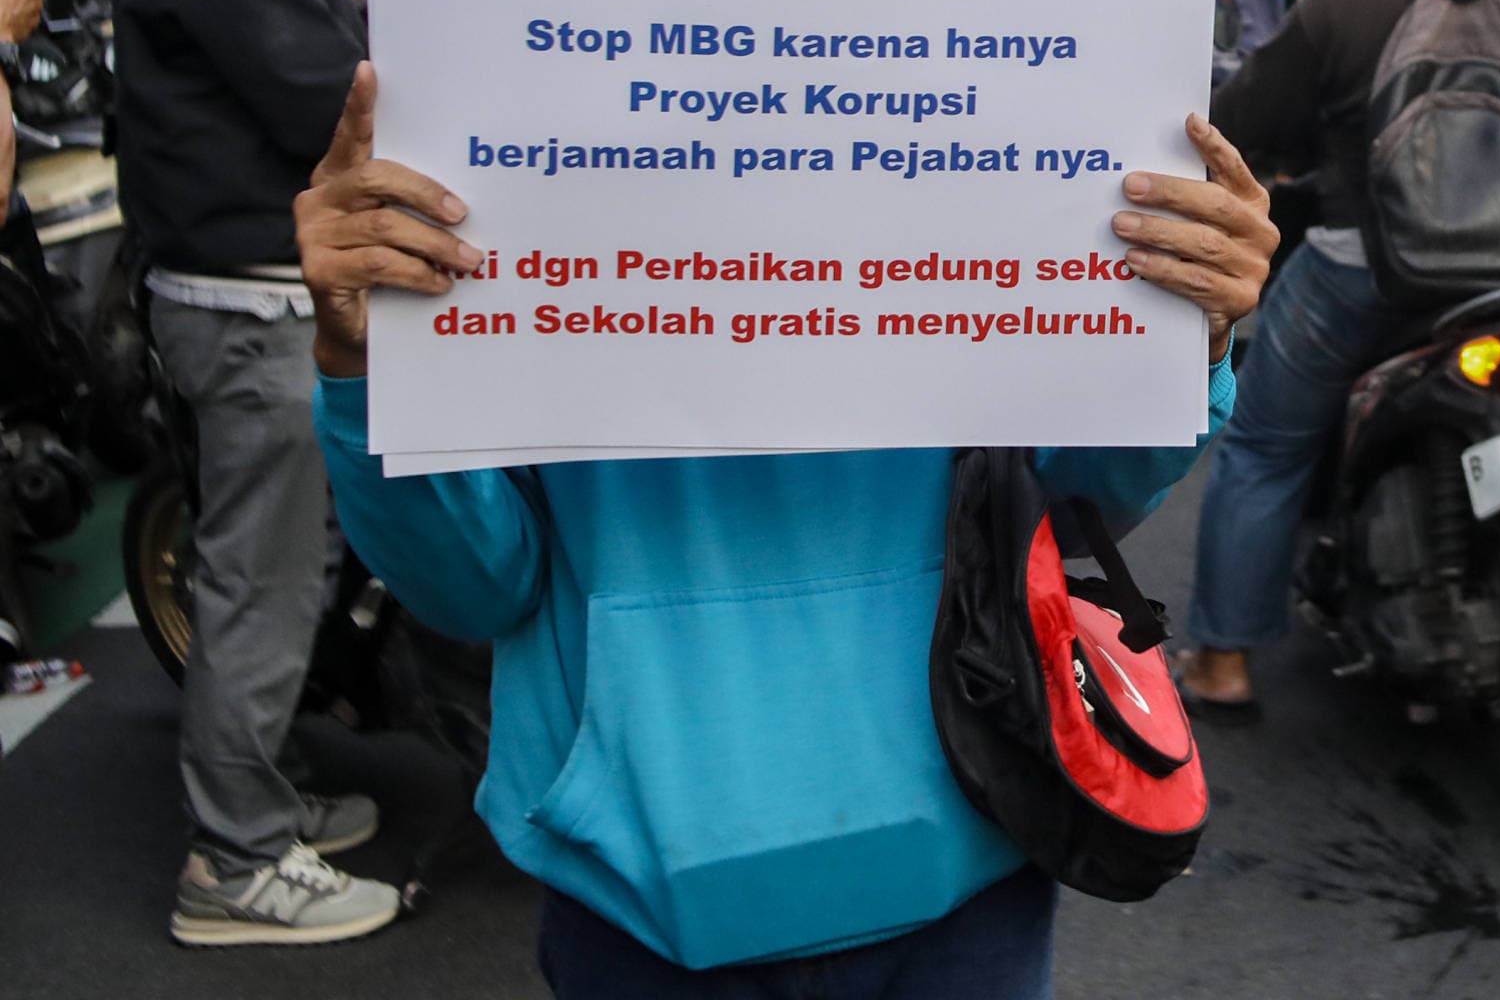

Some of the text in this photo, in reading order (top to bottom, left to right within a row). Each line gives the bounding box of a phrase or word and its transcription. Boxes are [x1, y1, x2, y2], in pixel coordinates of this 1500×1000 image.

[527, 19, 1077, 66] Stop MBG karena hanya
[629, 80, 977, 121] Proyek Korupsi
[468, 135, 1124, 179] berjamaah para Pejabat nya.
[516, 250, 599, 287] dgn
[616, 250, 843, 281] Perbaikan
[858, 252, 1021, 290] gedung
[433, 303, 1147, 344] dan Sekolah gratis menyeluruh.
[1468, 455, 1484, 483] B
